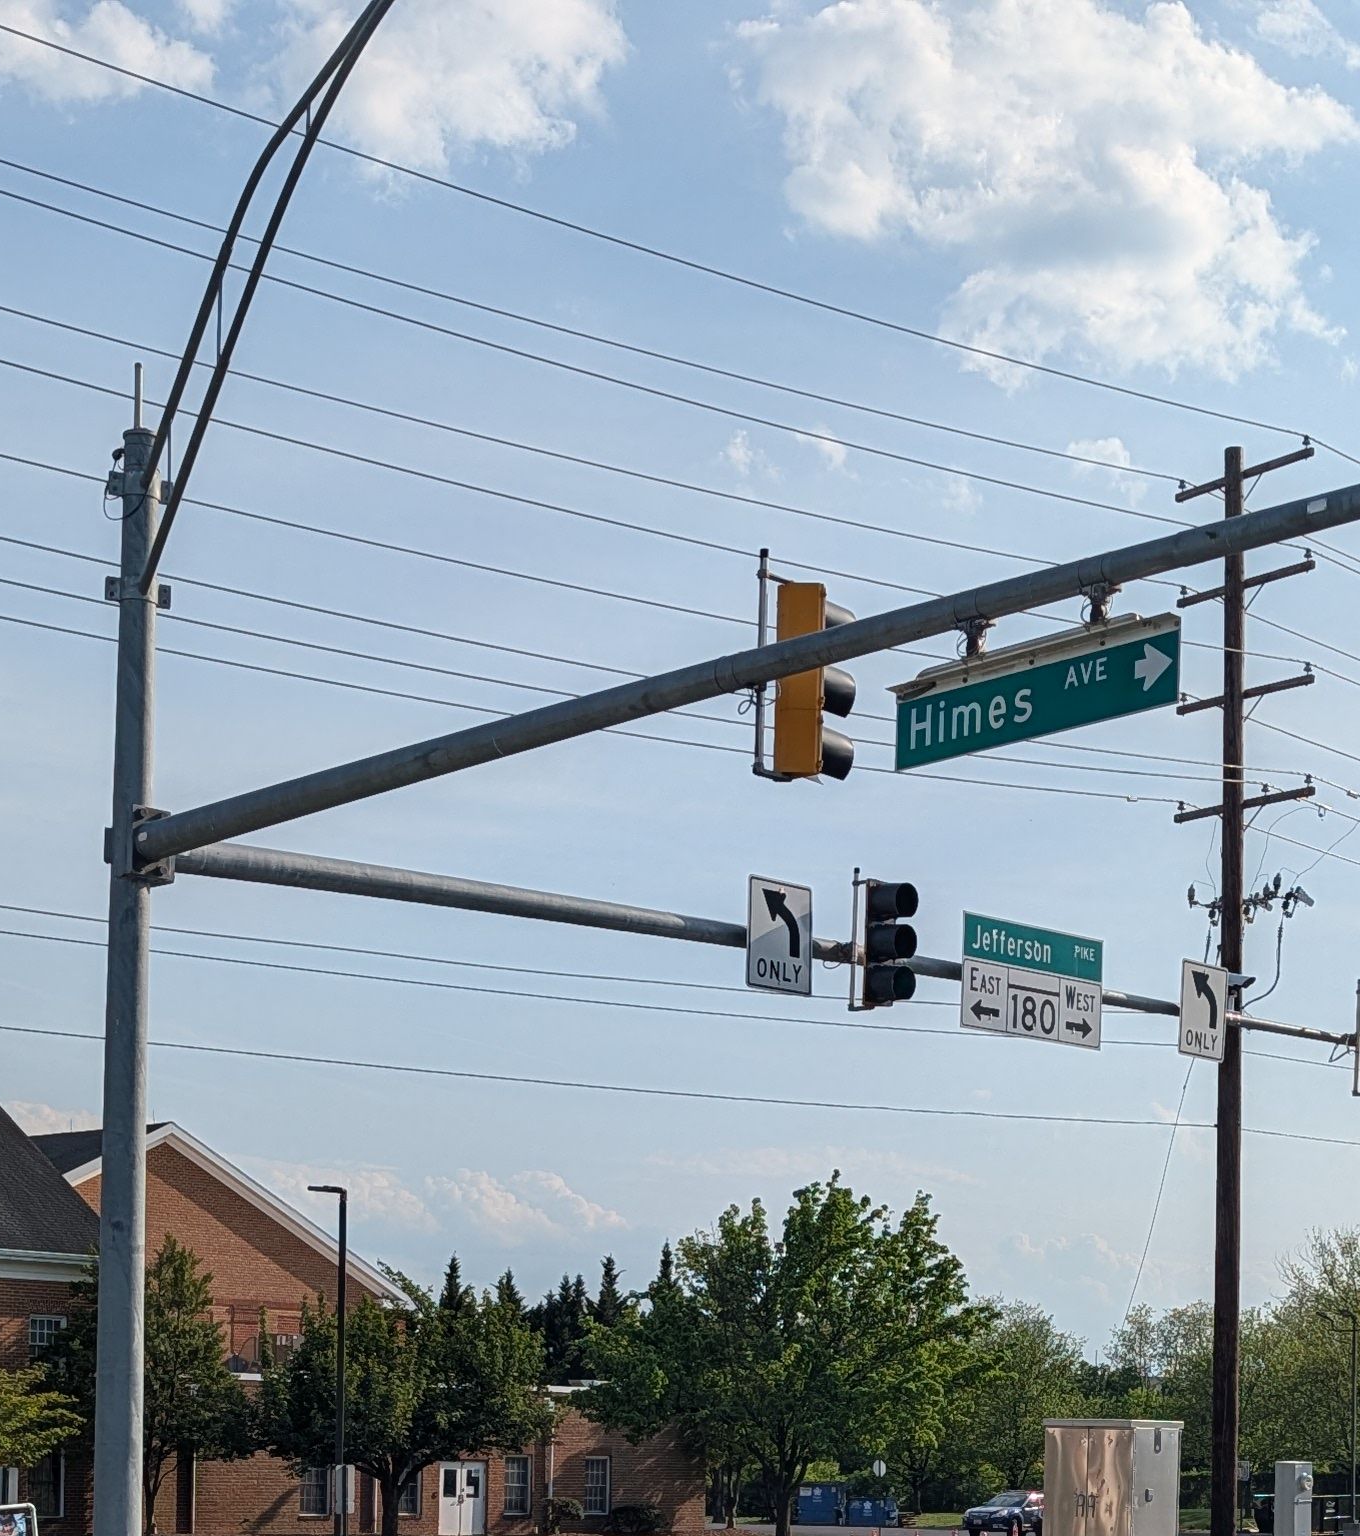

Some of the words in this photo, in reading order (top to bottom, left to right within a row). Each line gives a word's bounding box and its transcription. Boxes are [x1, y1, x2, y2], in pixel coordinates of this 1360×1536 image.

[910, 688, 1033, 750] Himes
[1064, 656, 1108, 690] AVE
[972, 924, 1052, 964] Jefferson
[1074, 945, 1095, 962] PIKE
[757, 957, 802, 984] ONLY
[969, 967, 1001, 996] EAST
[1065, 985, 1096, 1013] WEST
[1011, 993, 1056, 1035] 180
[1185, 1029, 1218, 1052] ONLY
